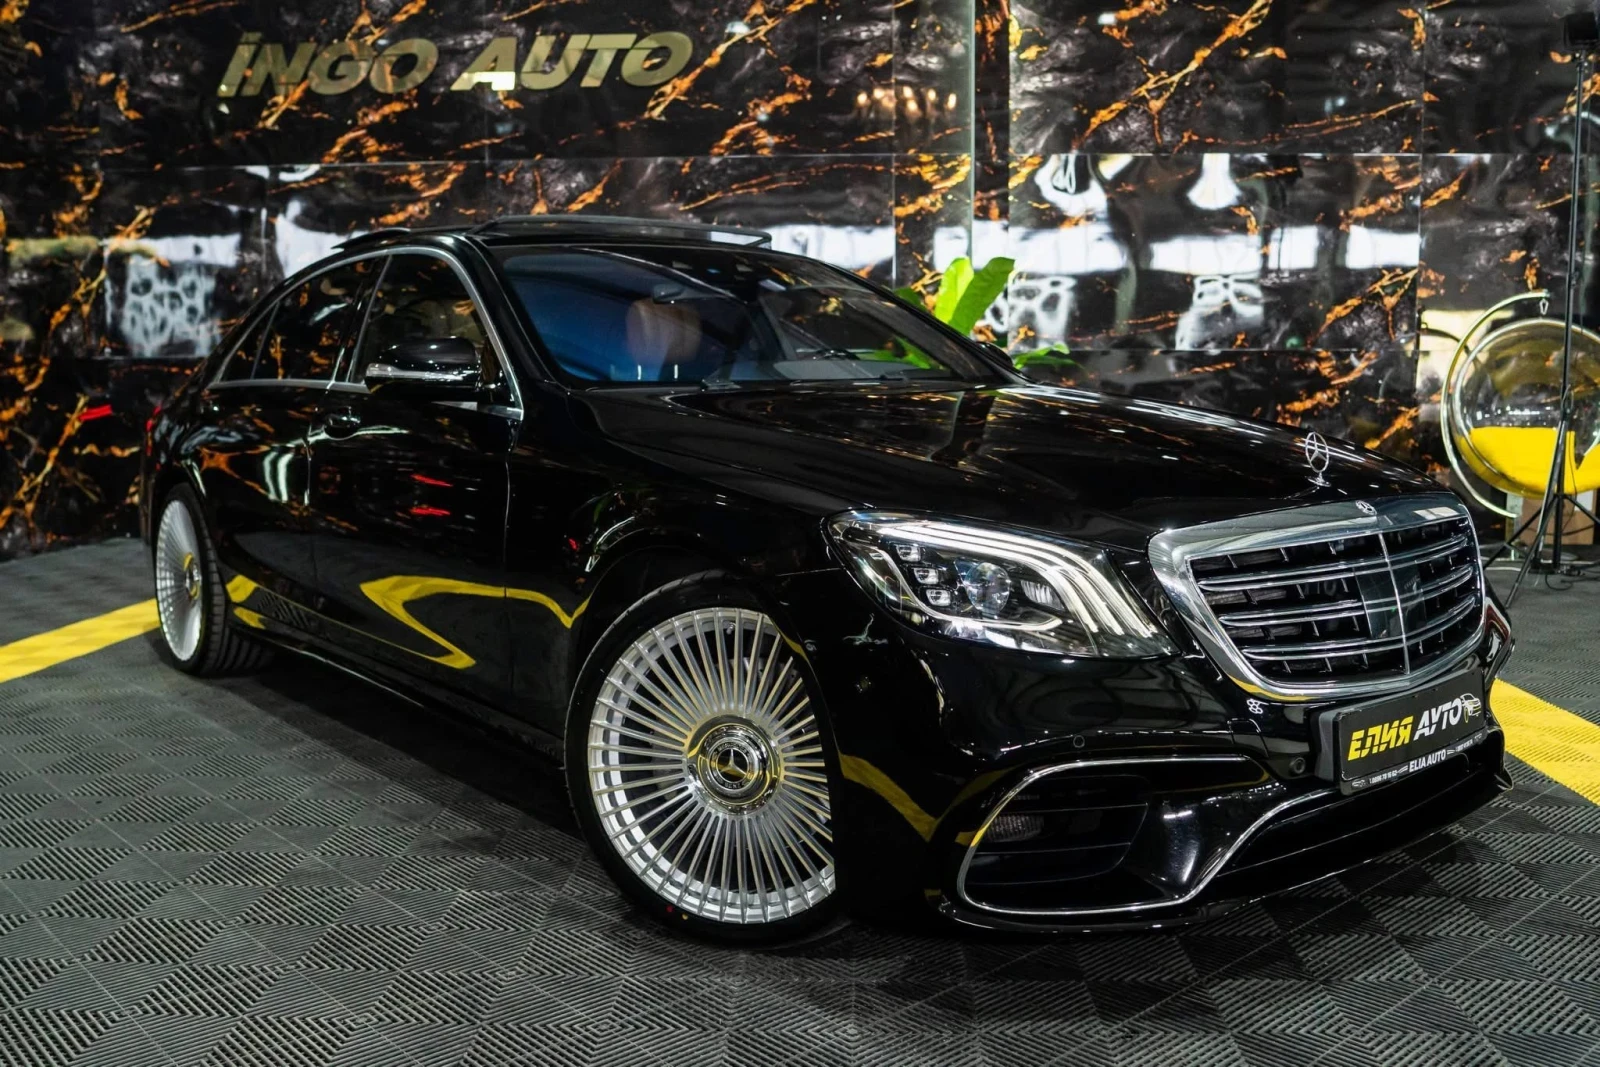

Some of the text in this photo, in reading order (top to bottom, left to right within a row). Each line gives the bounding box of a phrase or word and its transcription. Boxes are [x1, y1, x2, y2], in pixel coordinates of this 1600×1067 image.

[450, 31, 694, 92] AUTO
[1347, 715, 1414, 761] ЕЛИЯ
[1408, 749, 1446, 773] ELIA AUTO
